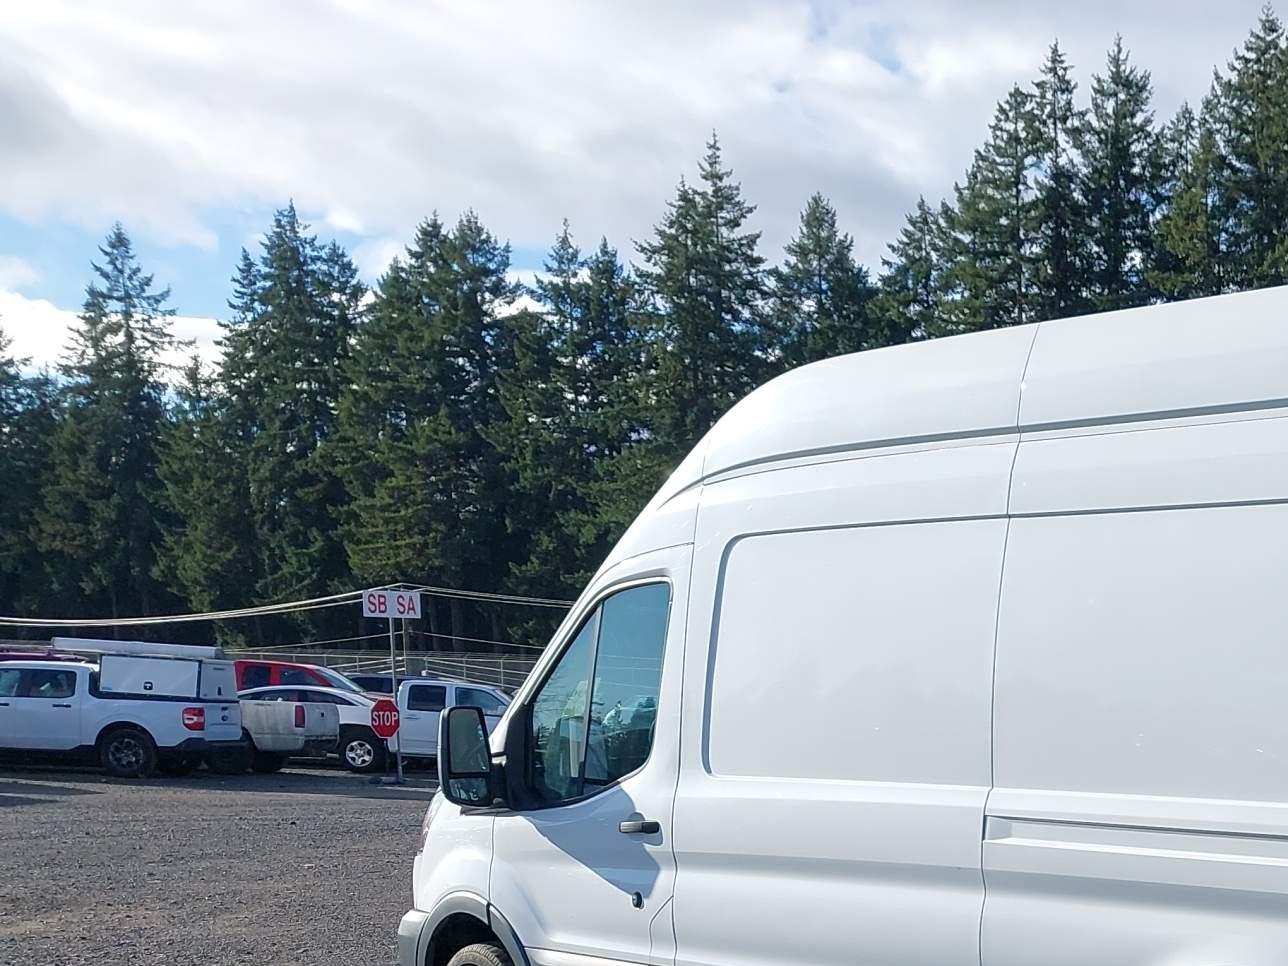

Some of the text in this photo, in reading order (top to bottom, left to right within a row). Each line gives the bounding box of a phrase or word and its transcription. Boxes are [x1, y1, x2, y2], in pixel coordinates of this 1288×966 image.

[368, 593, 416, 615] SB SA
[372, 711, 398, 726] STOP
